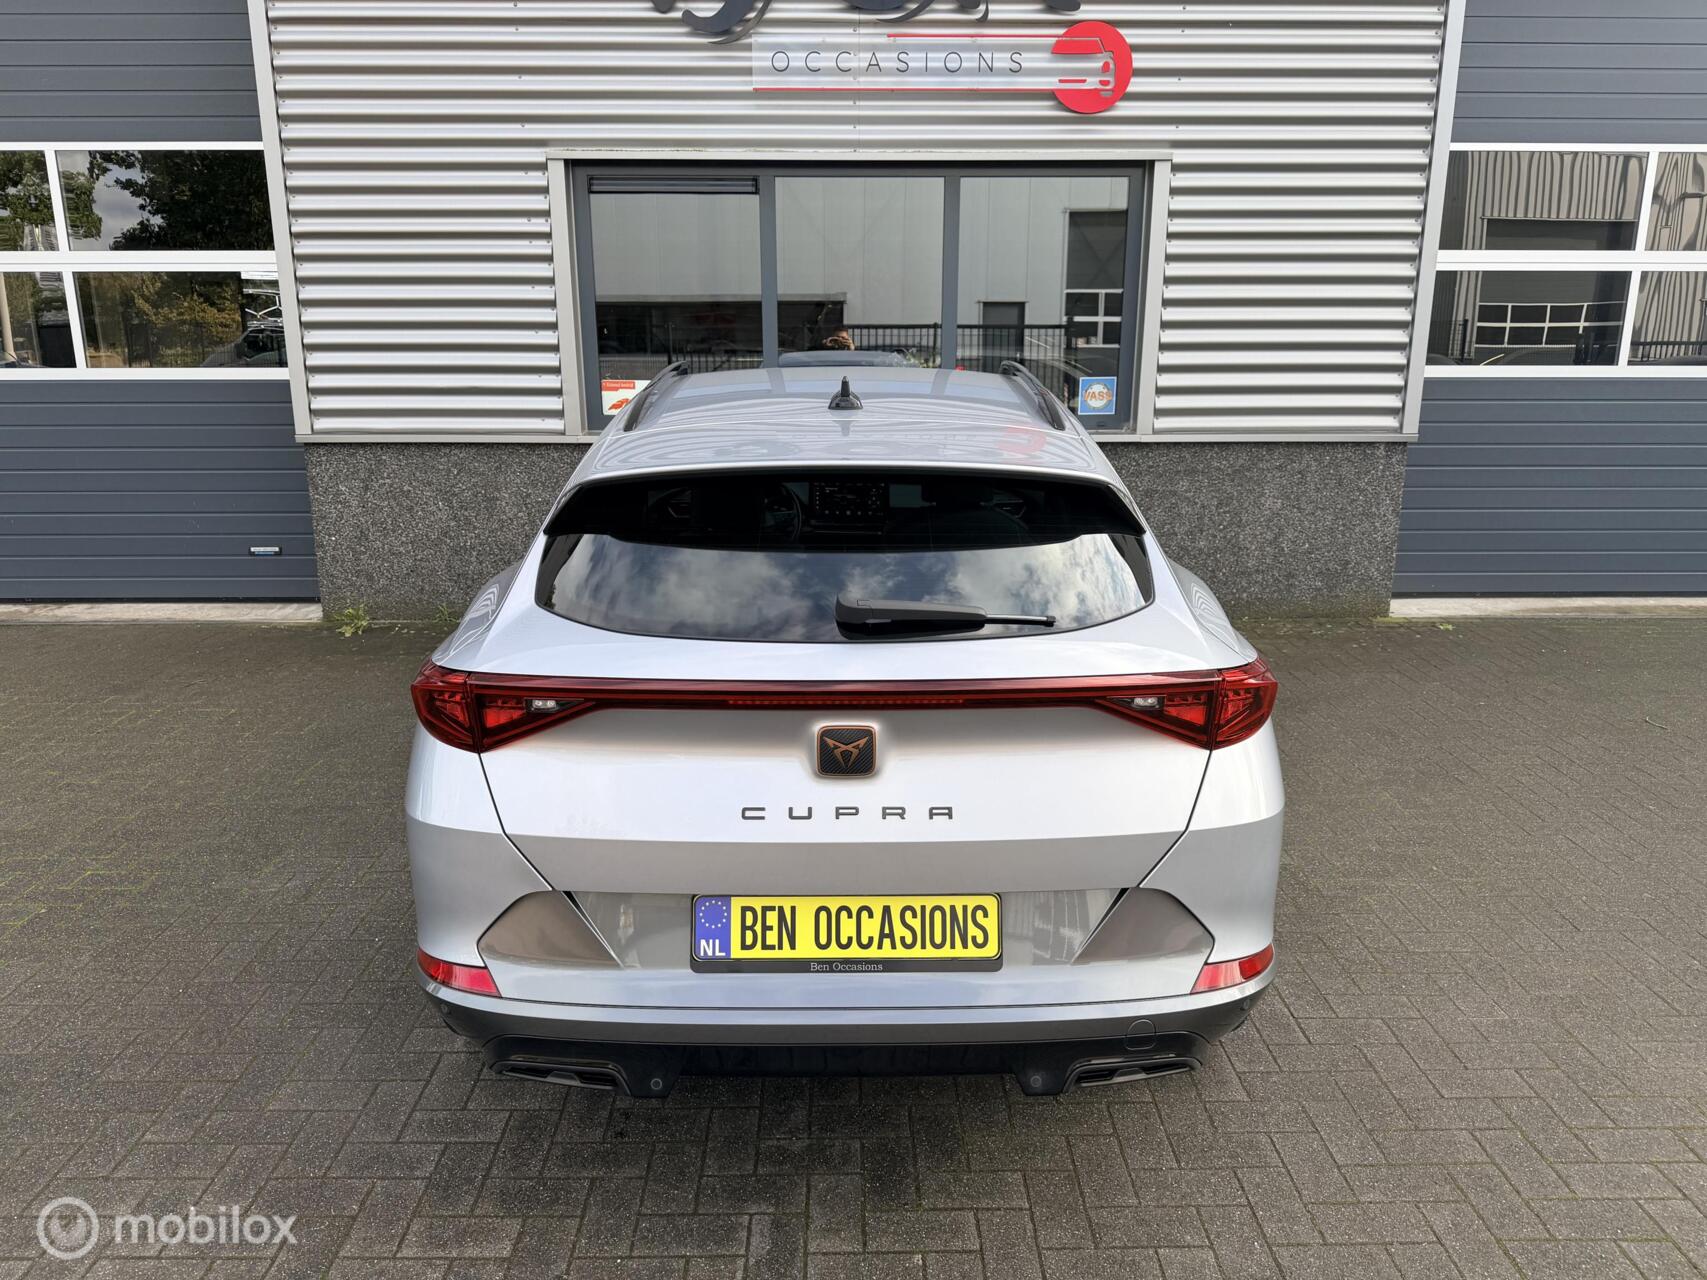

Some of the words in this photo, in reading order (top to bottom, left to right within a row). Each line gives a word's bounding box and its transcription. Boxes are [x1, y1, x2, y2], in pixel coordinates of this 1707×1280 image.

[770, 50, 1023, 74] OCCASIONS
[741, 806, 953, 820] CUPRA
[740, 905, 797, 951] BEN
[814, 904, 989, 950] OCCASIONS
[700, 939, 726, 956] NL
[810, 962, 830, 972] Ben
[832, 962, 883, 972] Occasions
